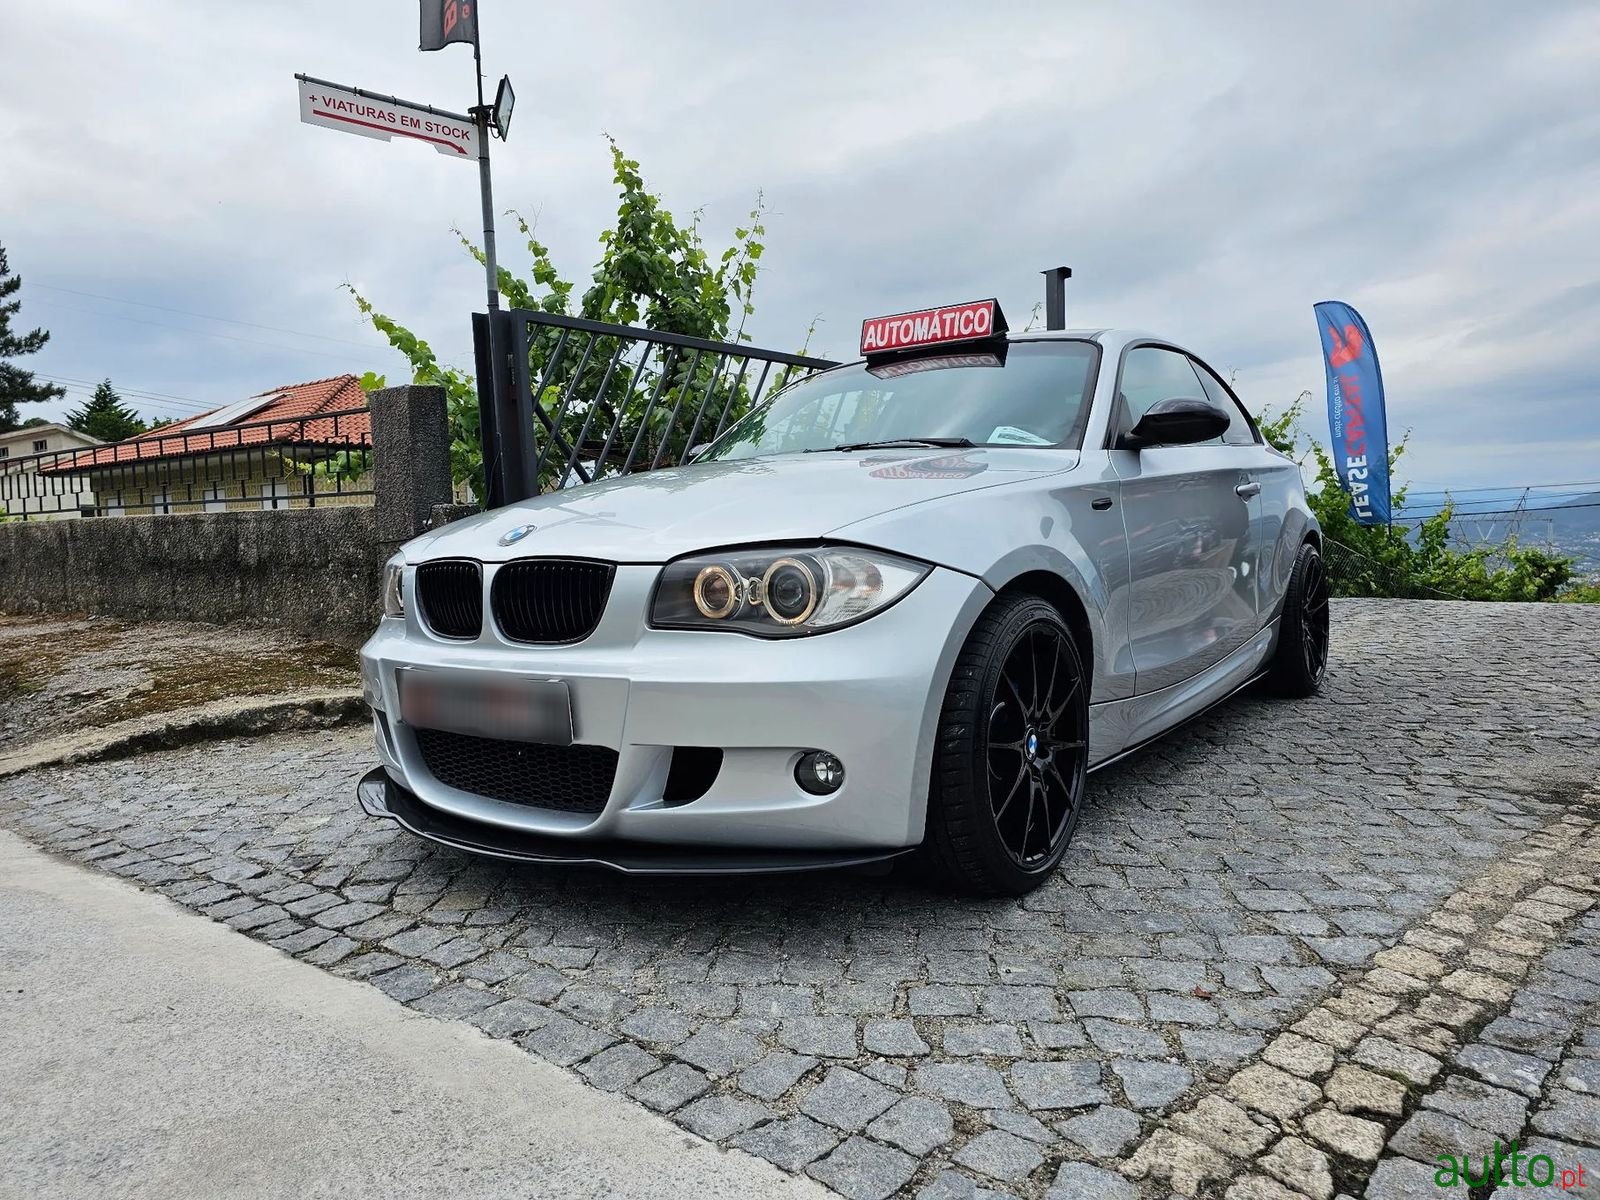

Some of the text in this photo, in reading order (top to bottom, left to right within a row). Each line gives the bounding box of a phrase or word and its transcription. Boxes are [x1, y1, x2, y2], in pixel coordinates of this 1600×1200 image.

[321, 95, 397, 124] VIATURAS
[401, 115, 421, 129] EM
[425, 121, 471, 141] STOCK
[863, 307, 990, 349] AUTOMÁTICO
